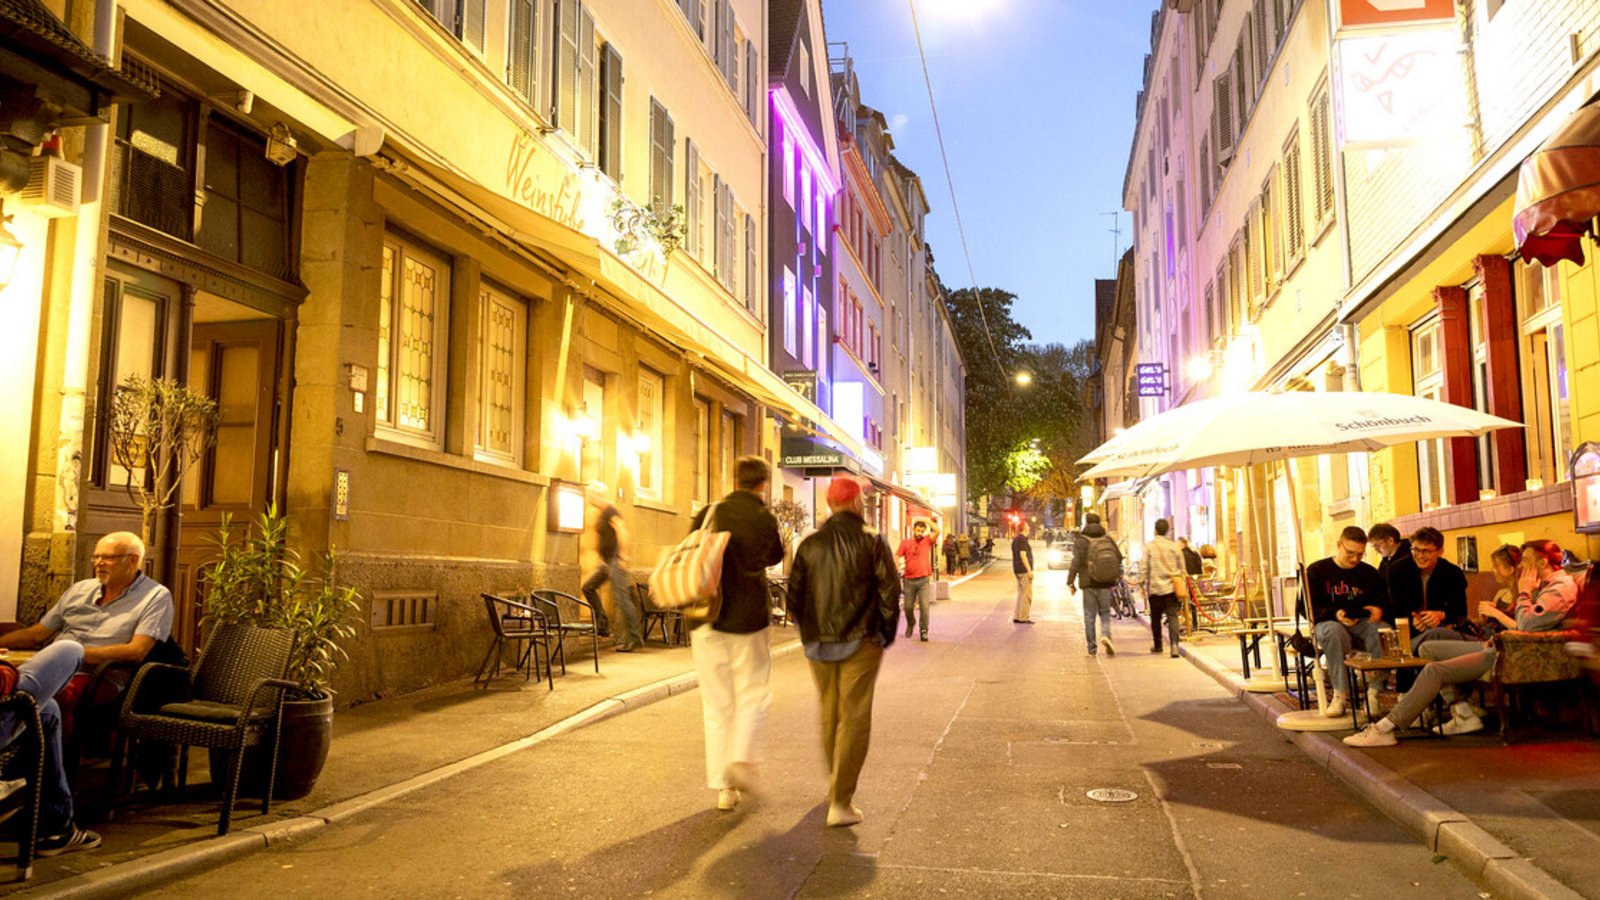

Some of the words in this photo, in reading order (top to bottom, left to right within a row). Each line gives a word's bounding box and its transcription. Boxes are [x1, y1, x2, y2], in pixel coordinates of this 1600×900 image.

[1335, 414, 1432, 432] Schönbuch
[785, 456, 802, 465] CLUB
[803, 456, 839, 464] MESSALINA
